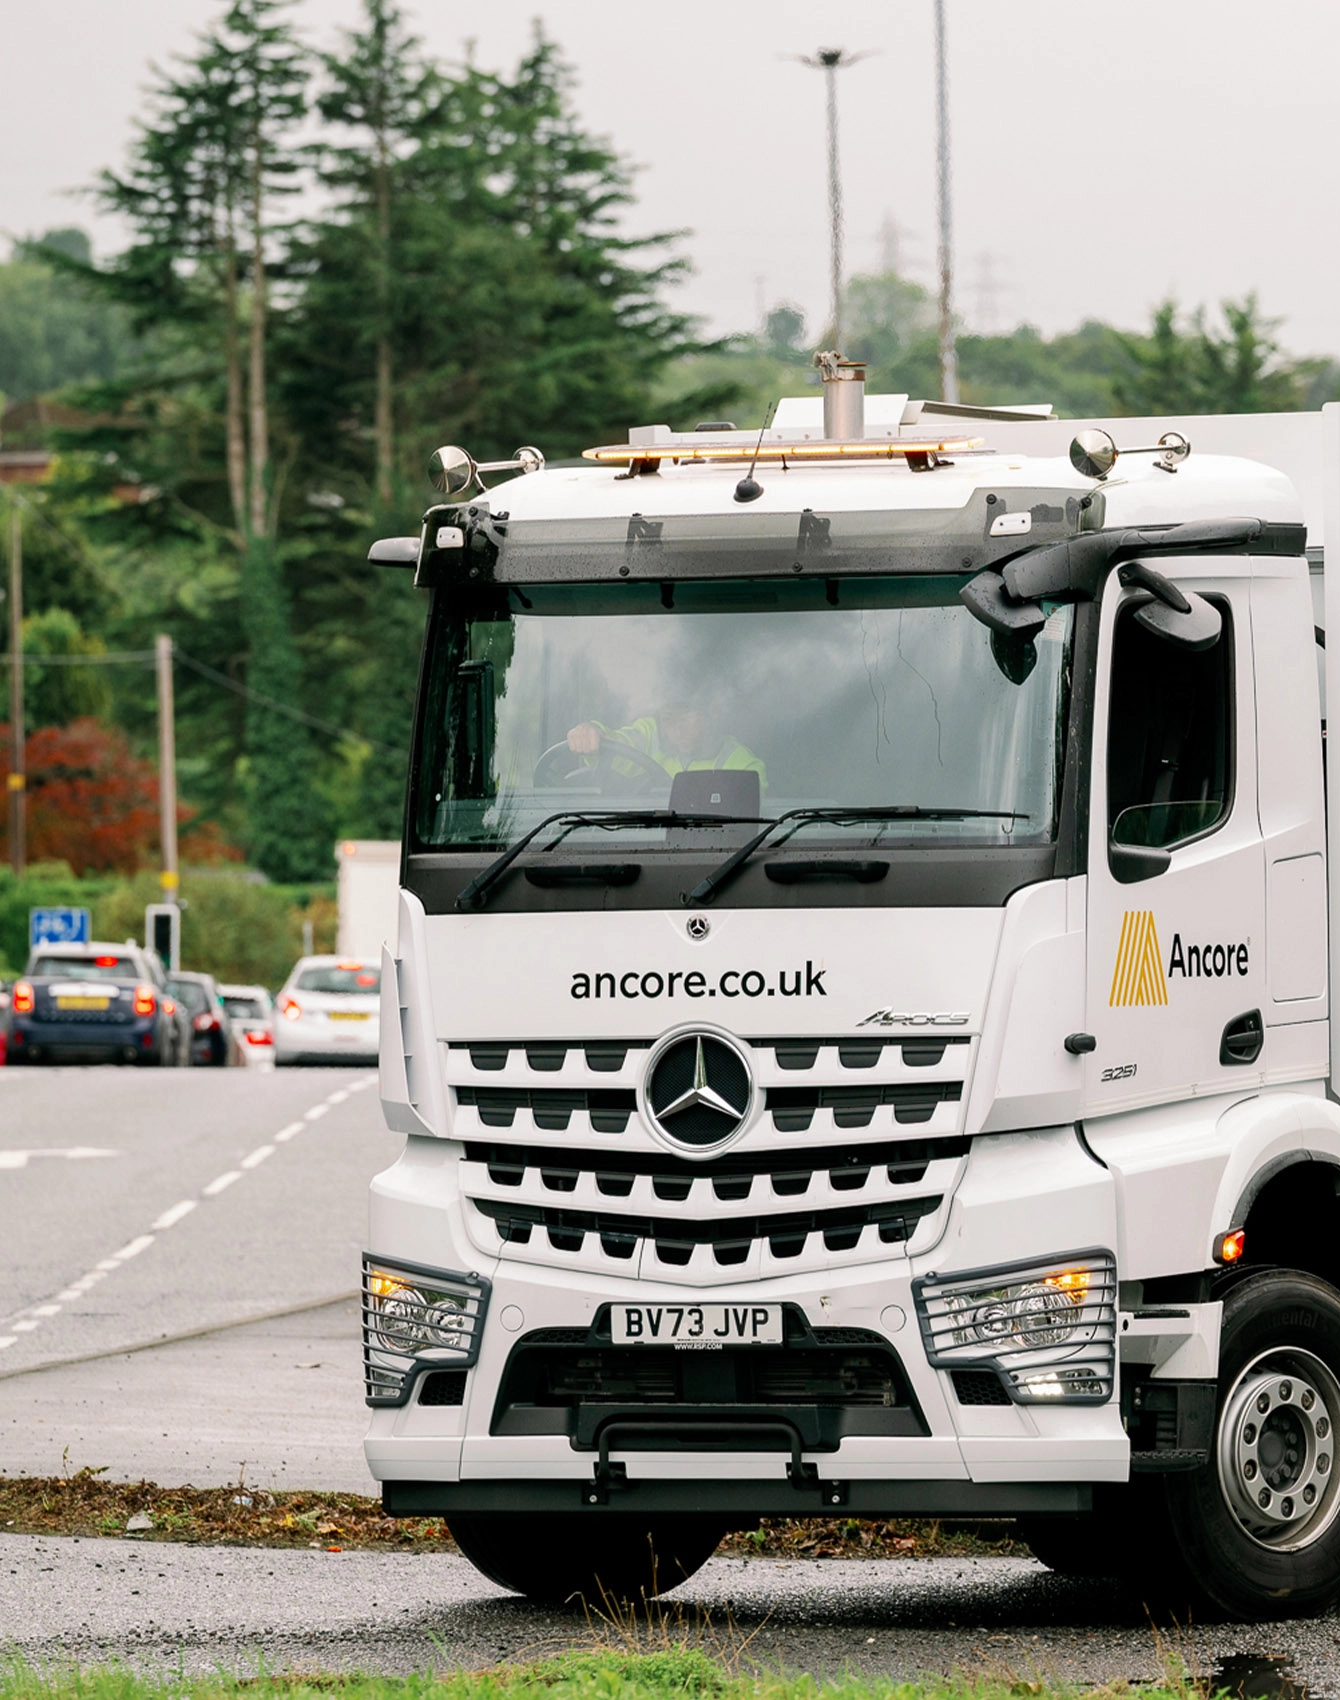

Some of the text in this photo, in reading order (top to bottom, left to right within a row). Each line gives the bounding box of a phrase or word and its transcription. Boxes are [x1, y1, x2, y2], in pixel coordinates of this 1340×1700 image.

[570, 960, 827, 1000] ancore.co.uk
[1100, 1063, 1138, 1083] 3251
[625, 1307, 769, 1337] BV73 JVP
